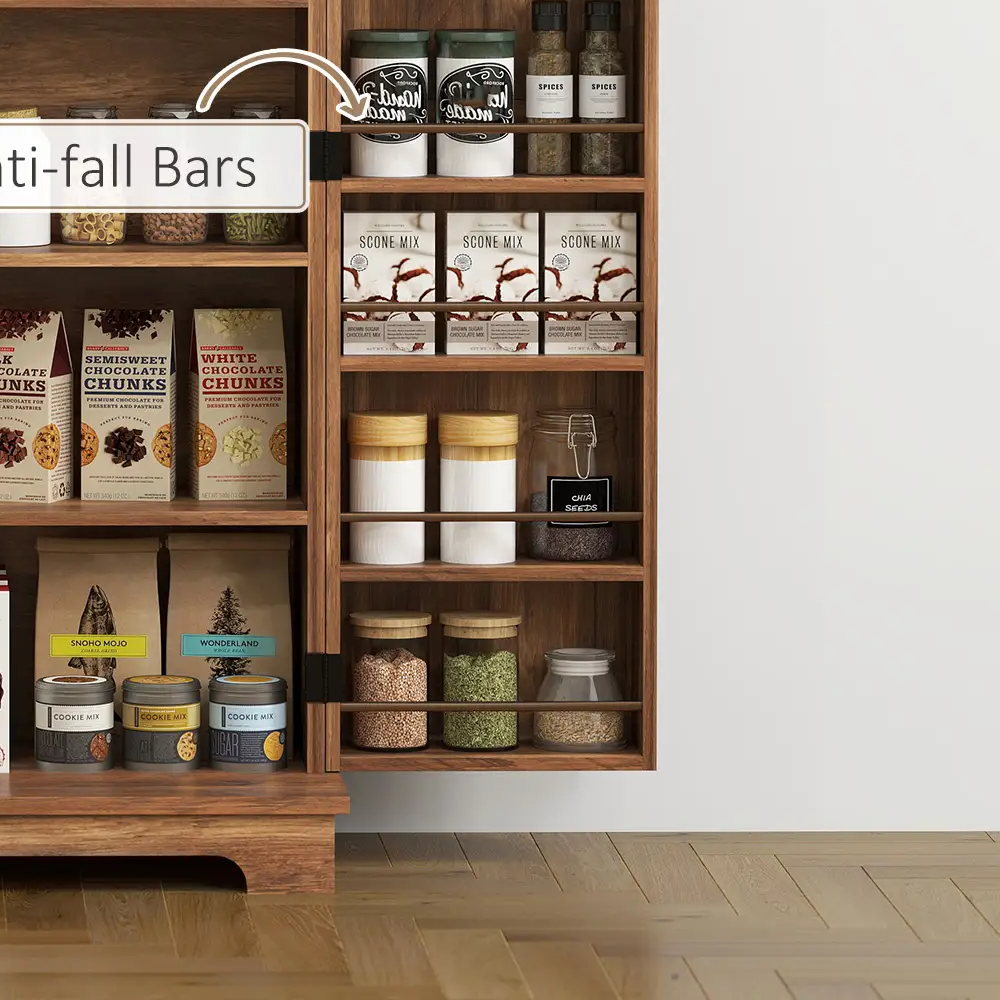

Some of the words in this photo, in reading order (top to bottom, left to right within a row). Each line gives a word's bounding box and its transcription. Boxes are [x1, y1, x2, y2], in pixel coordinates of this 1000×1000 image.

[359, 235, 395, 248] SCONE
[400, 235, 420, 248] MIX
[463, 235, 498, 248] SCONE
[504, 235, 523, 248] MIX
[561, 235, 596, 248] SCONE
[602, 235, 621, 248] MIX
[85, 356, 167, 364] SEMISWEET
[201, 354, 257, 363] WHITE
[84, 367, 166, 375] CHOCOLATE
[202, 366, 283, 374] CHOCOLATE
[84, 378, 166, 390] CHUNKS
[202, 377, 284, 389] CHUNKS
[565, 504, 598, 512] SEEDS
